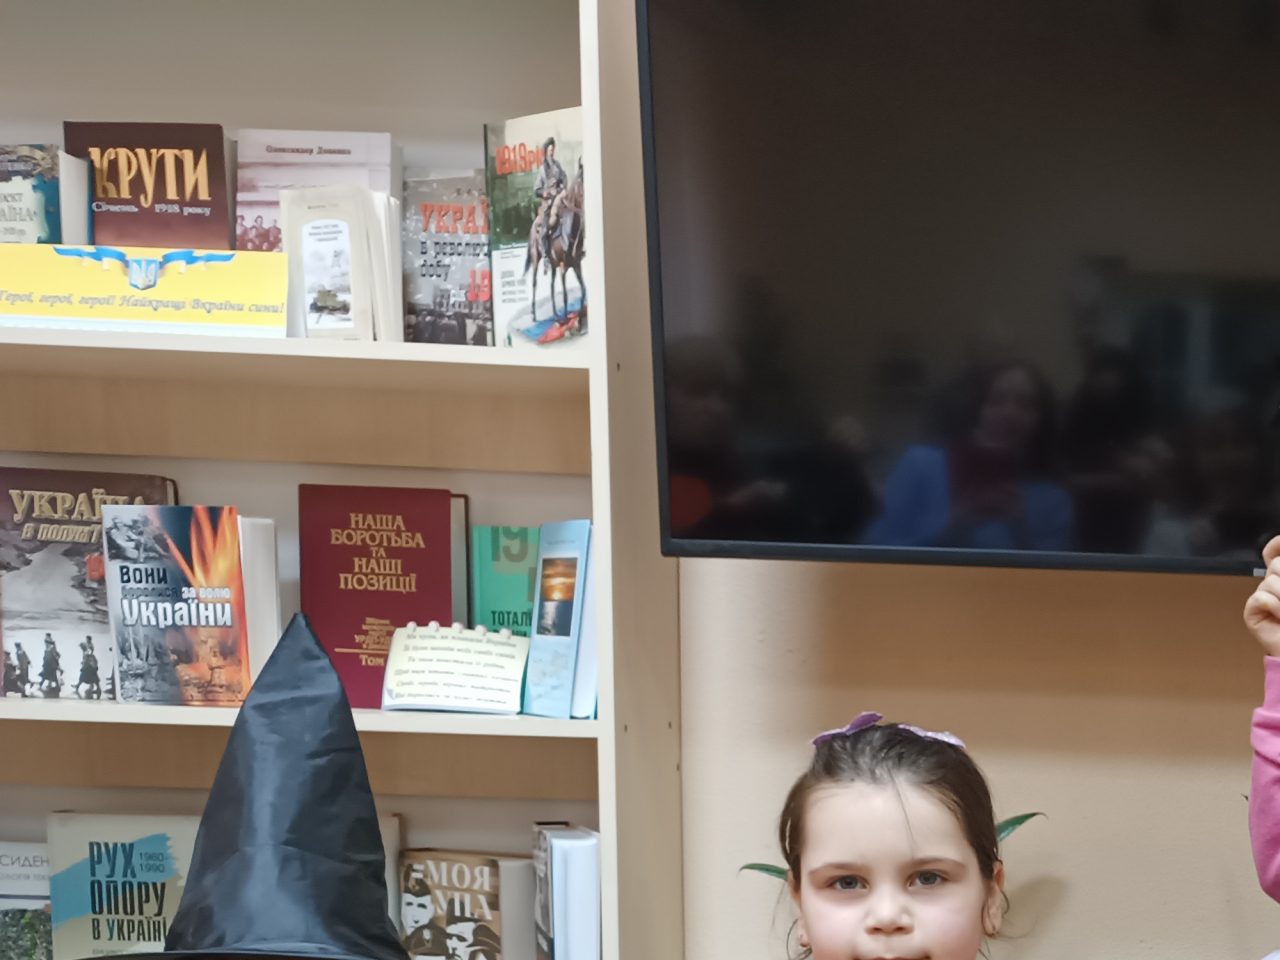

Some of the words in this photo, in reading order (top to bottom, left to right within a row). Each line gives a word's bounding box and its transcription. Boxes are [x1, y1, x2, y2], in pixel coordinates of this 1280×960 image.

[88, 147, 212, 208] КРУТИ
[420, 259, 451, 282] добу
[9, 488, 146, 525] УКРАЇ
[350, 513, 406, 531] НАША
[330, 529, 426, 549] БОРОТЬБА
[370, 548, 386, 558] ТА
[119, 565, 168, 585] Вони
[353, 558, 402, 575] НАШІ
[182, 587, 196, 600] за
[339, 573, 417, 593] ПОЗИЦІЇ
[120, 598, 233, 628] України
[88, 841, 137, 879] РУХ
[425, 859, 493, 892] МОЯ
[90, 879, 166, 916] ОПОРУ
[92, 919, 100, 940] В
[107, 917, 168, 942] УКРАЇНІ
